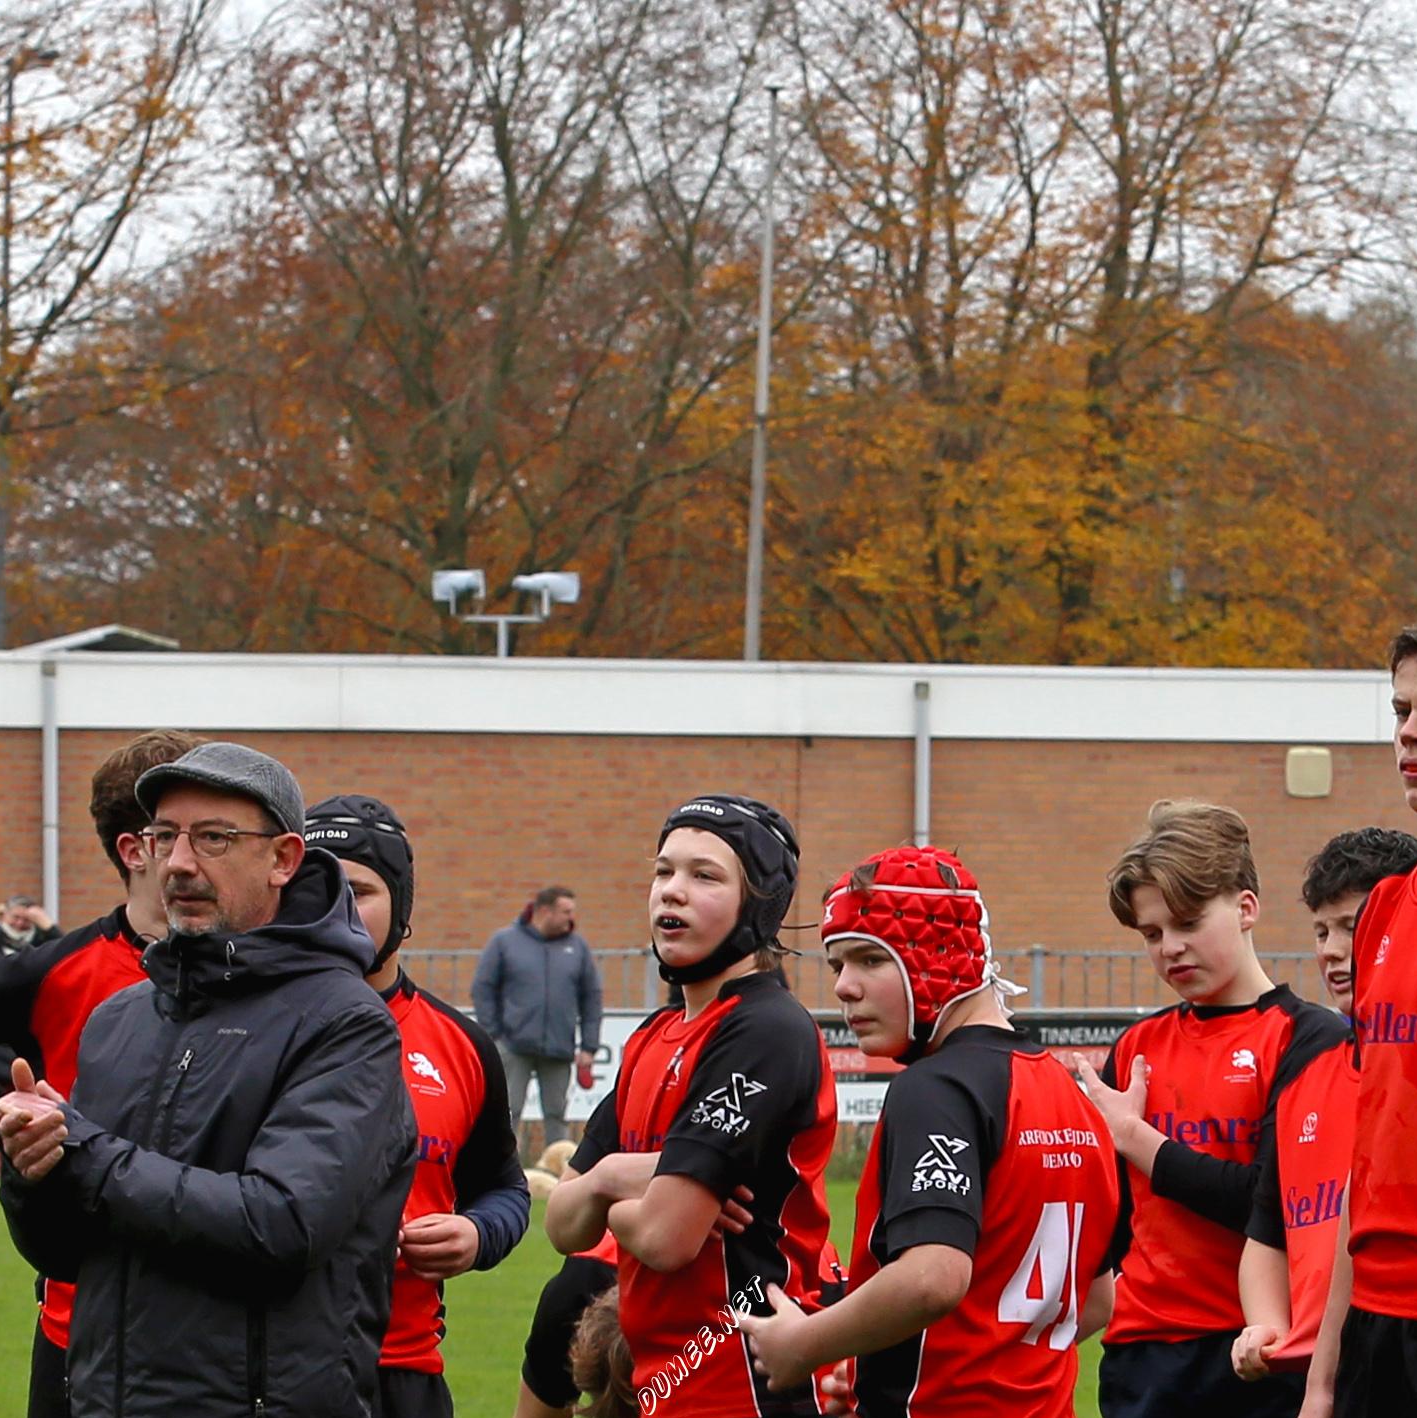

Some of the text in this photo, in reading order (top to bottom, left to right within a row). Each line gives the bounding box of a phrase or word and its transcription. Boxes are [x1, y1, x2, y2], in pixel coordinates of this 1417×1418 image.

[690, 1113, 744, 1138] SPORT
[694, 1101, 751, 1132] XAVI
[911, 1180, 970, 1196] SPORT
[913, 1169, 970, 1188] XAVI
